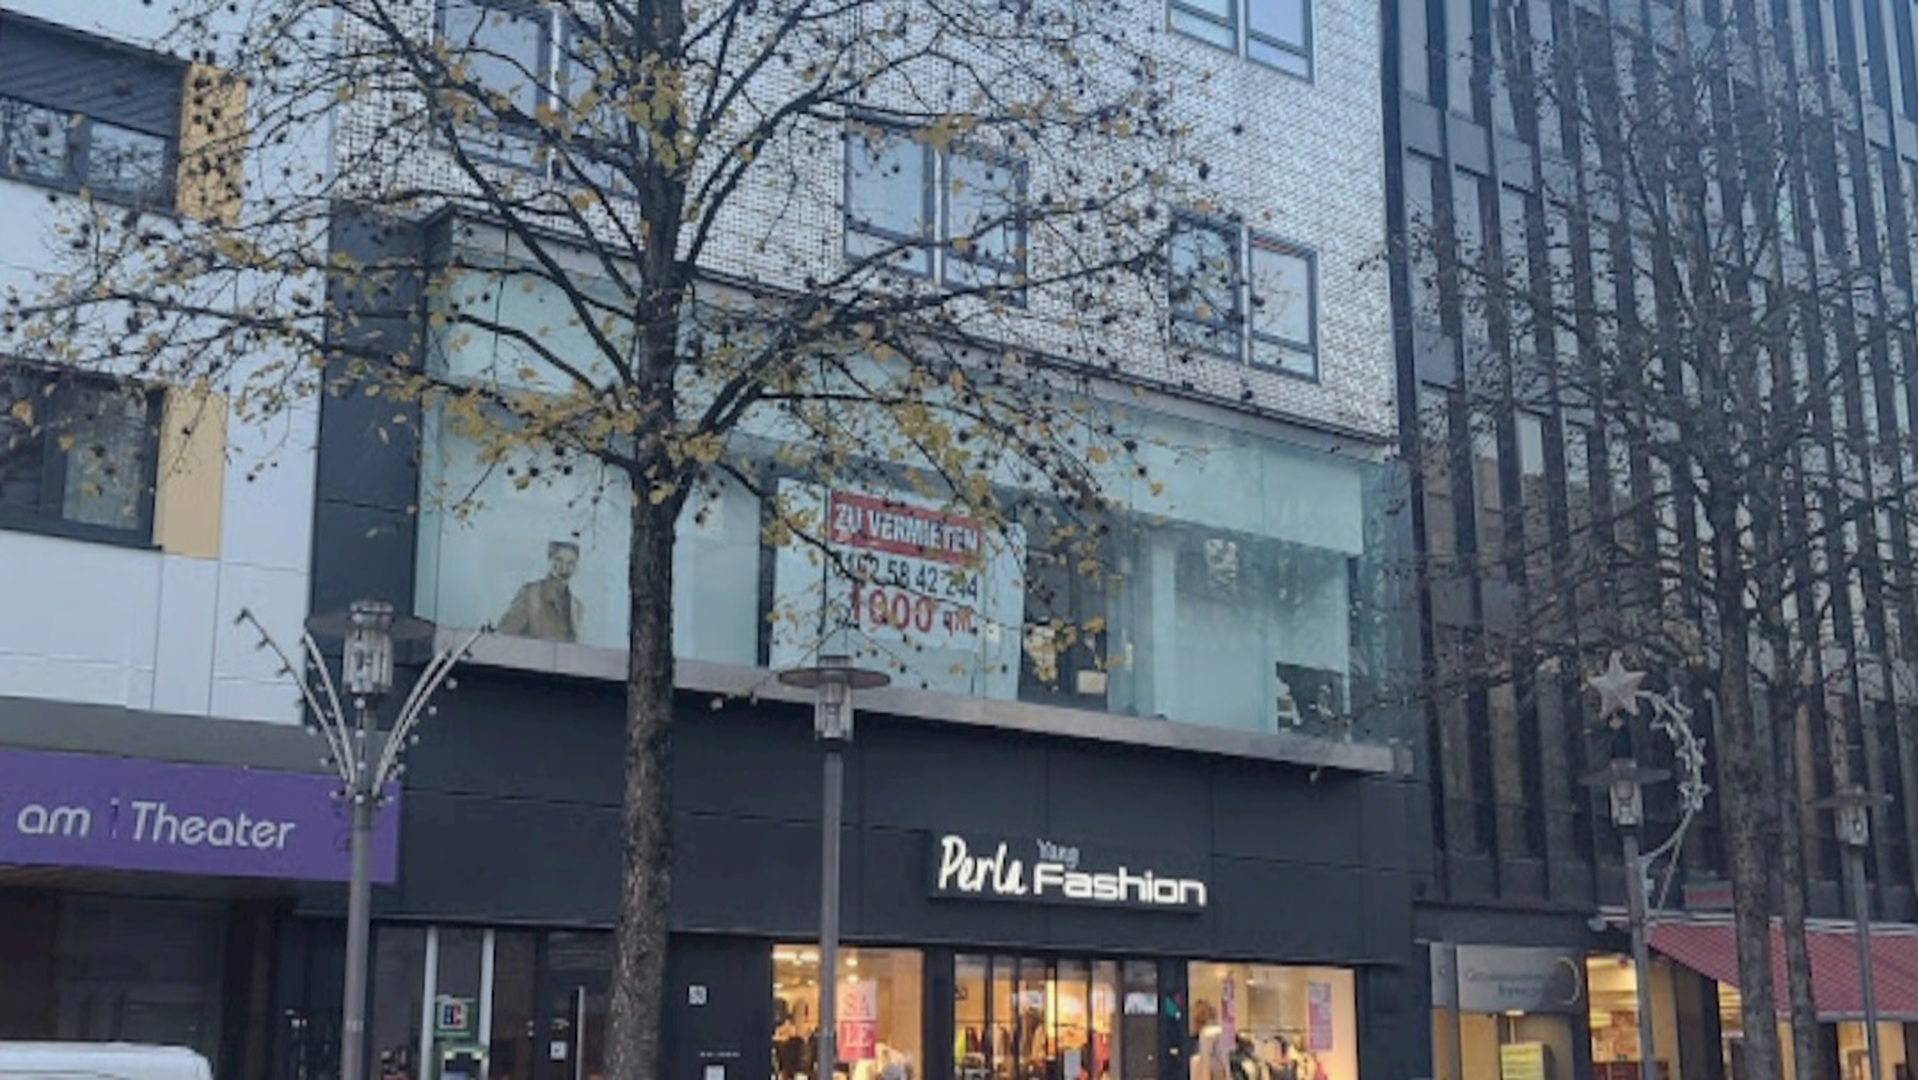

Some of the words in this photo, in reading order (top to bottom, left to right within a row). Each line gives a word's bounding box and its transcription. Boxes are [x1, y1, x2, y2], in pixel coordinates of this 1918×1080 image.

[834, 503, 862, 534] ZU
[866, 509, 979, 552] VERMIETEN
[915, 564, 938, 594] 42
[17, 803, 92, 838] am
[131, 800, 297, 850] Theater
[1033, 862, 1208, 907] Fashion
